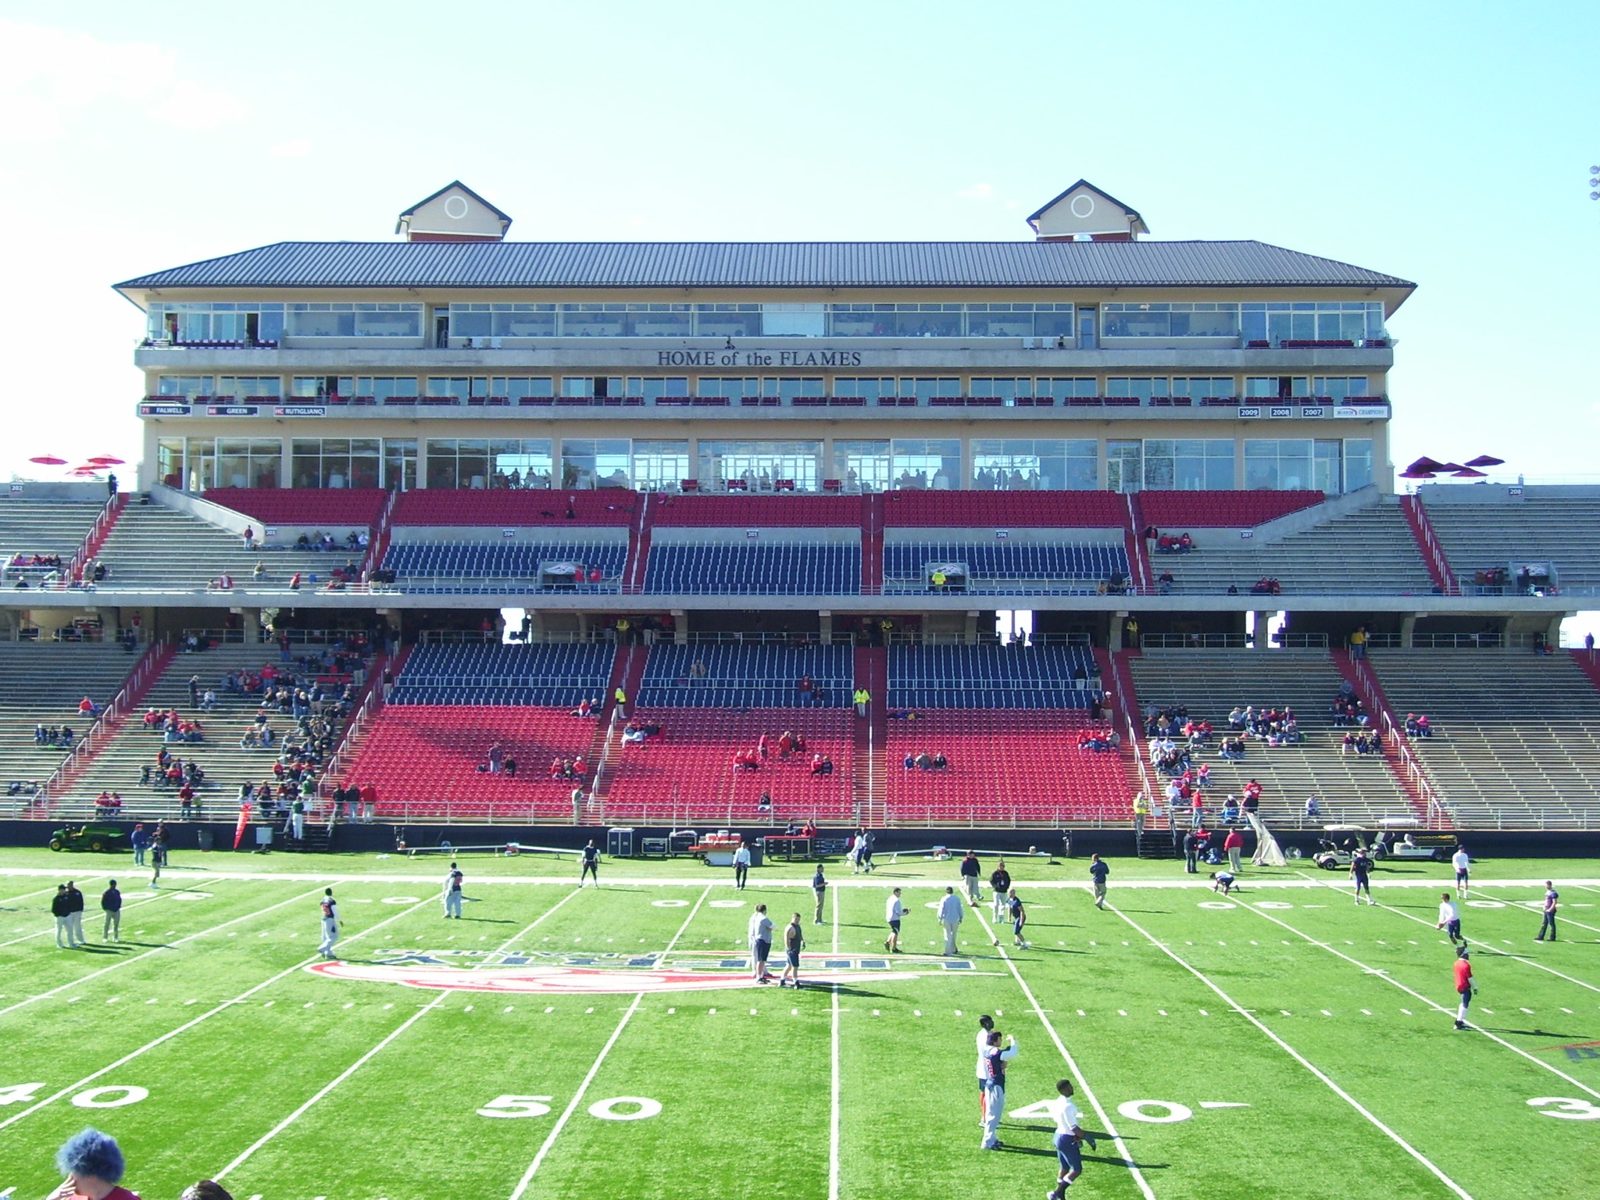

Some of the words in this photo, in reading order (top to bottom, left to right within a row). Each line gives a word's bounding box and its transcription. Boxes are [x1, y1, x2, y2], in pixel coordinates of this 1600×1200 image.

[658, 351, 715, 366] HOME
[721, 351, 739, 366] of
[746, 352, 772, 366] the
[779, 351, 862, 366] FLAMES
